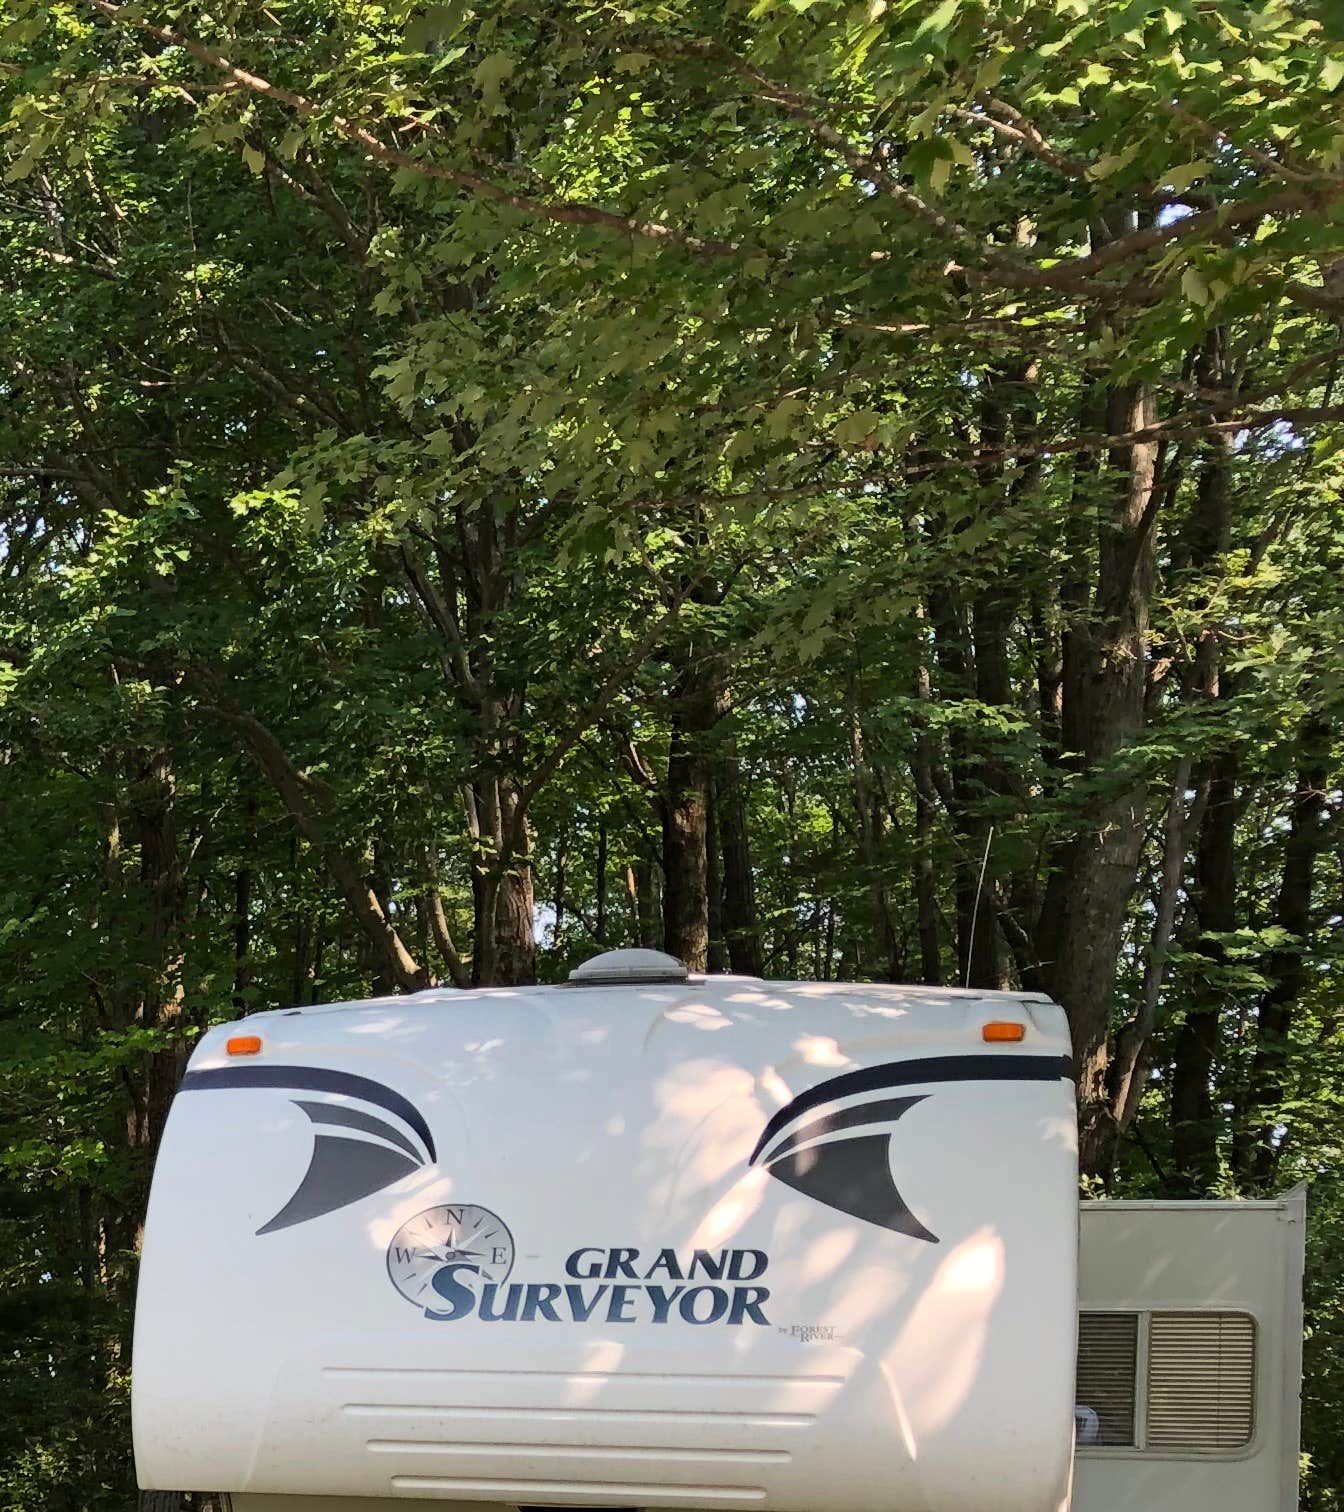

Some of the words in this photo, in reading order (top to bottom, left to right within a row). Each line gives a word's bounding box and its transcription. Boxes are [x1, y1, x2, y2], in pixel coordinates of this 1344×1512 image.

[445, 1208, 464, 1225] N
[394, 1247, 416, 1265] W
[490, 1247, 507, 1265] E
[565, 1247, 769, 1281] GRAND
[423, 1263, 772, 1326] SURVEYOR
